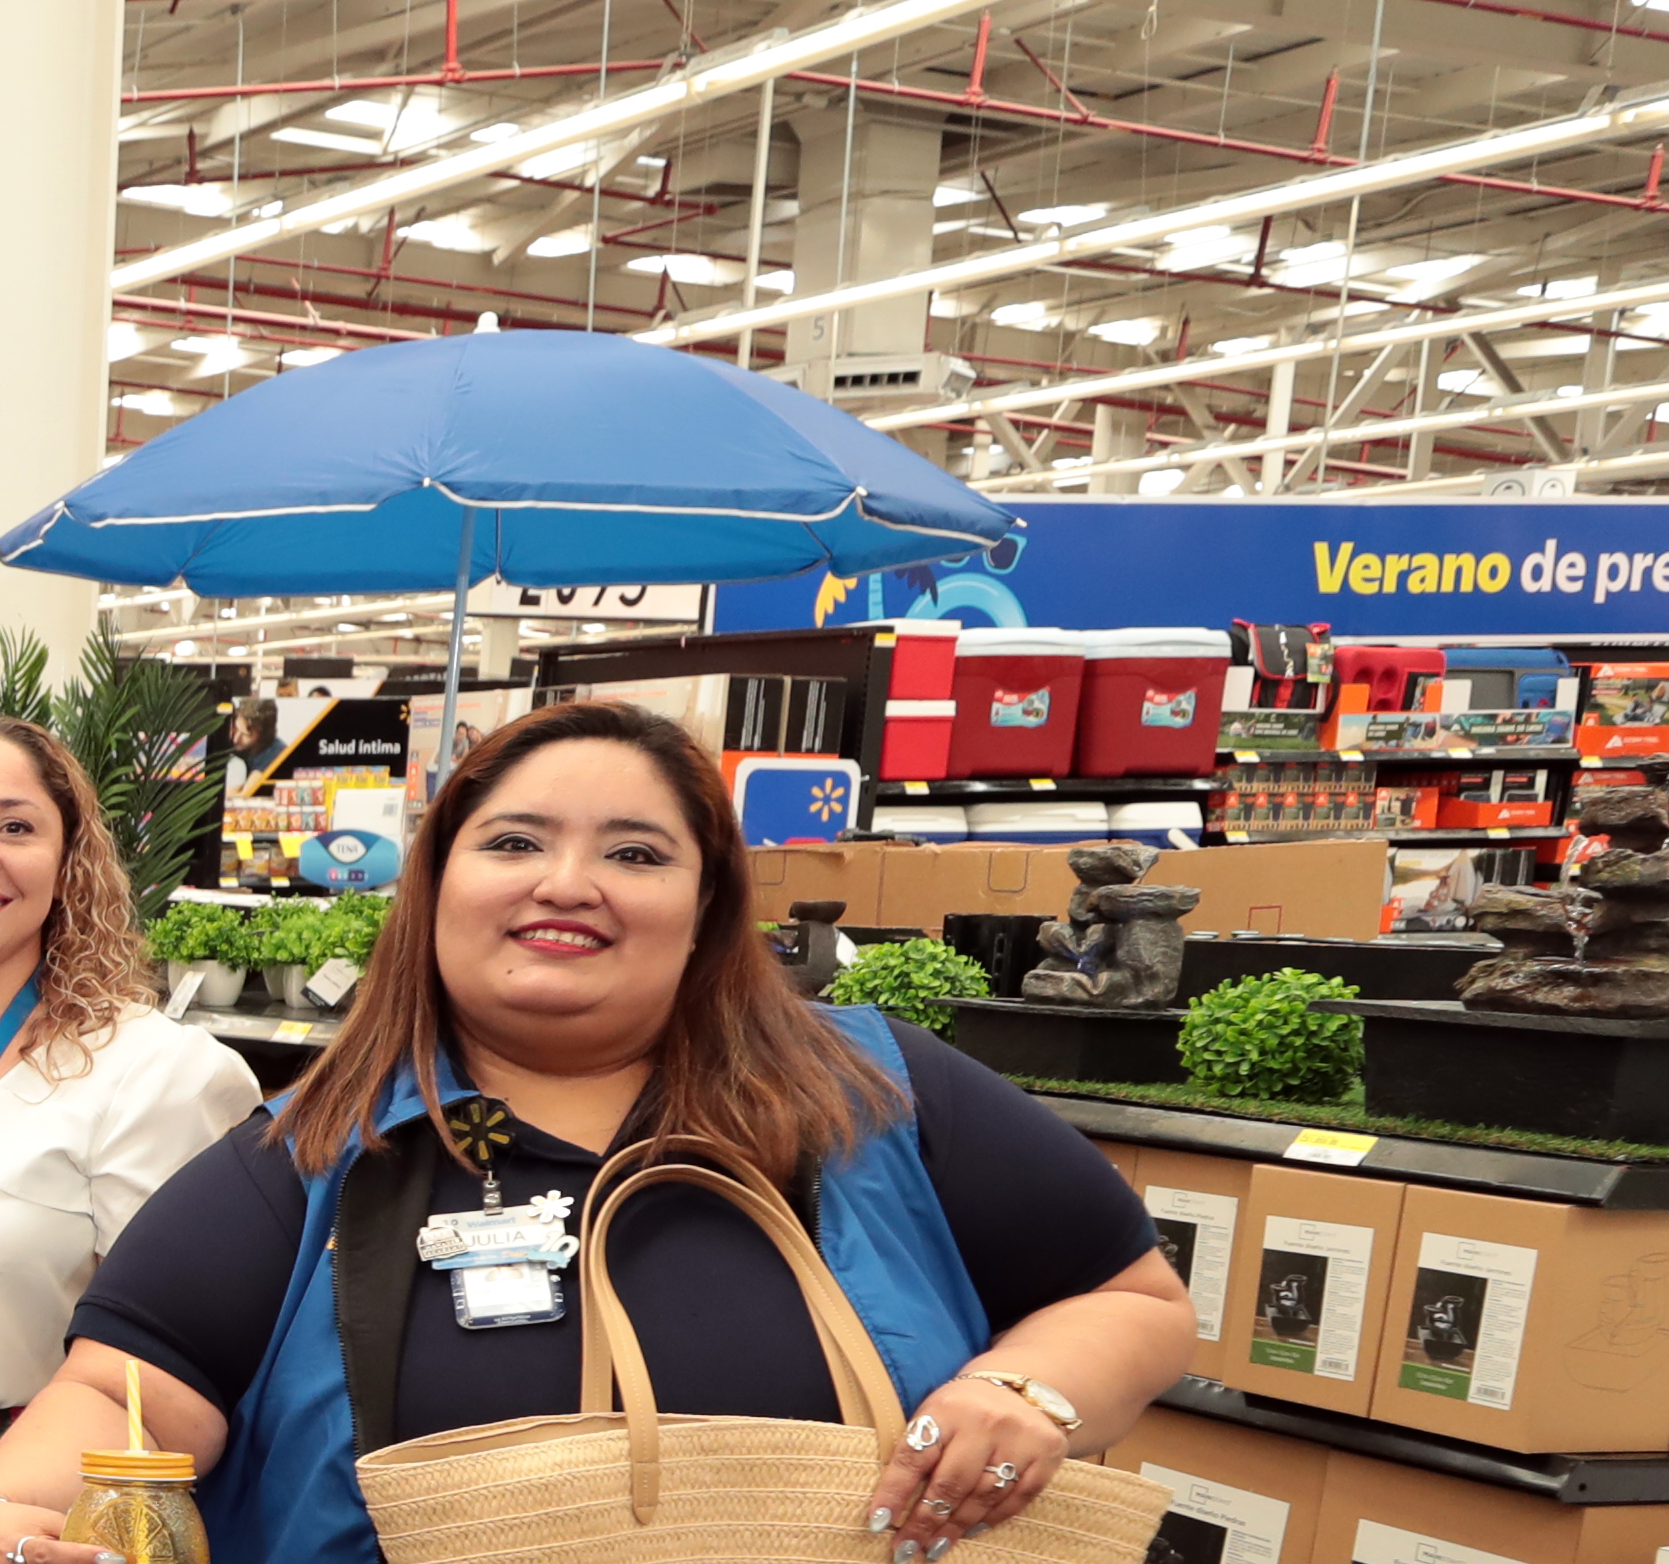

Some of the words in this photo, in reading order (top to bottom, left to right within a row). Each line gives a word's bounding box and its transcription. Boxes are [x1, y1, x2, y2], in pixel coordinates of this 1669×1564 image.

[1313, 541, 1512, 595] Verano
[1520, 538, 1587, 594] de
[318, 738, 356, 755] Salud
[358, 738, 402, 755] íntima
[465, 1216, 517, 1228] Walmart
[465, 1230, 527, 1248] JULIA
